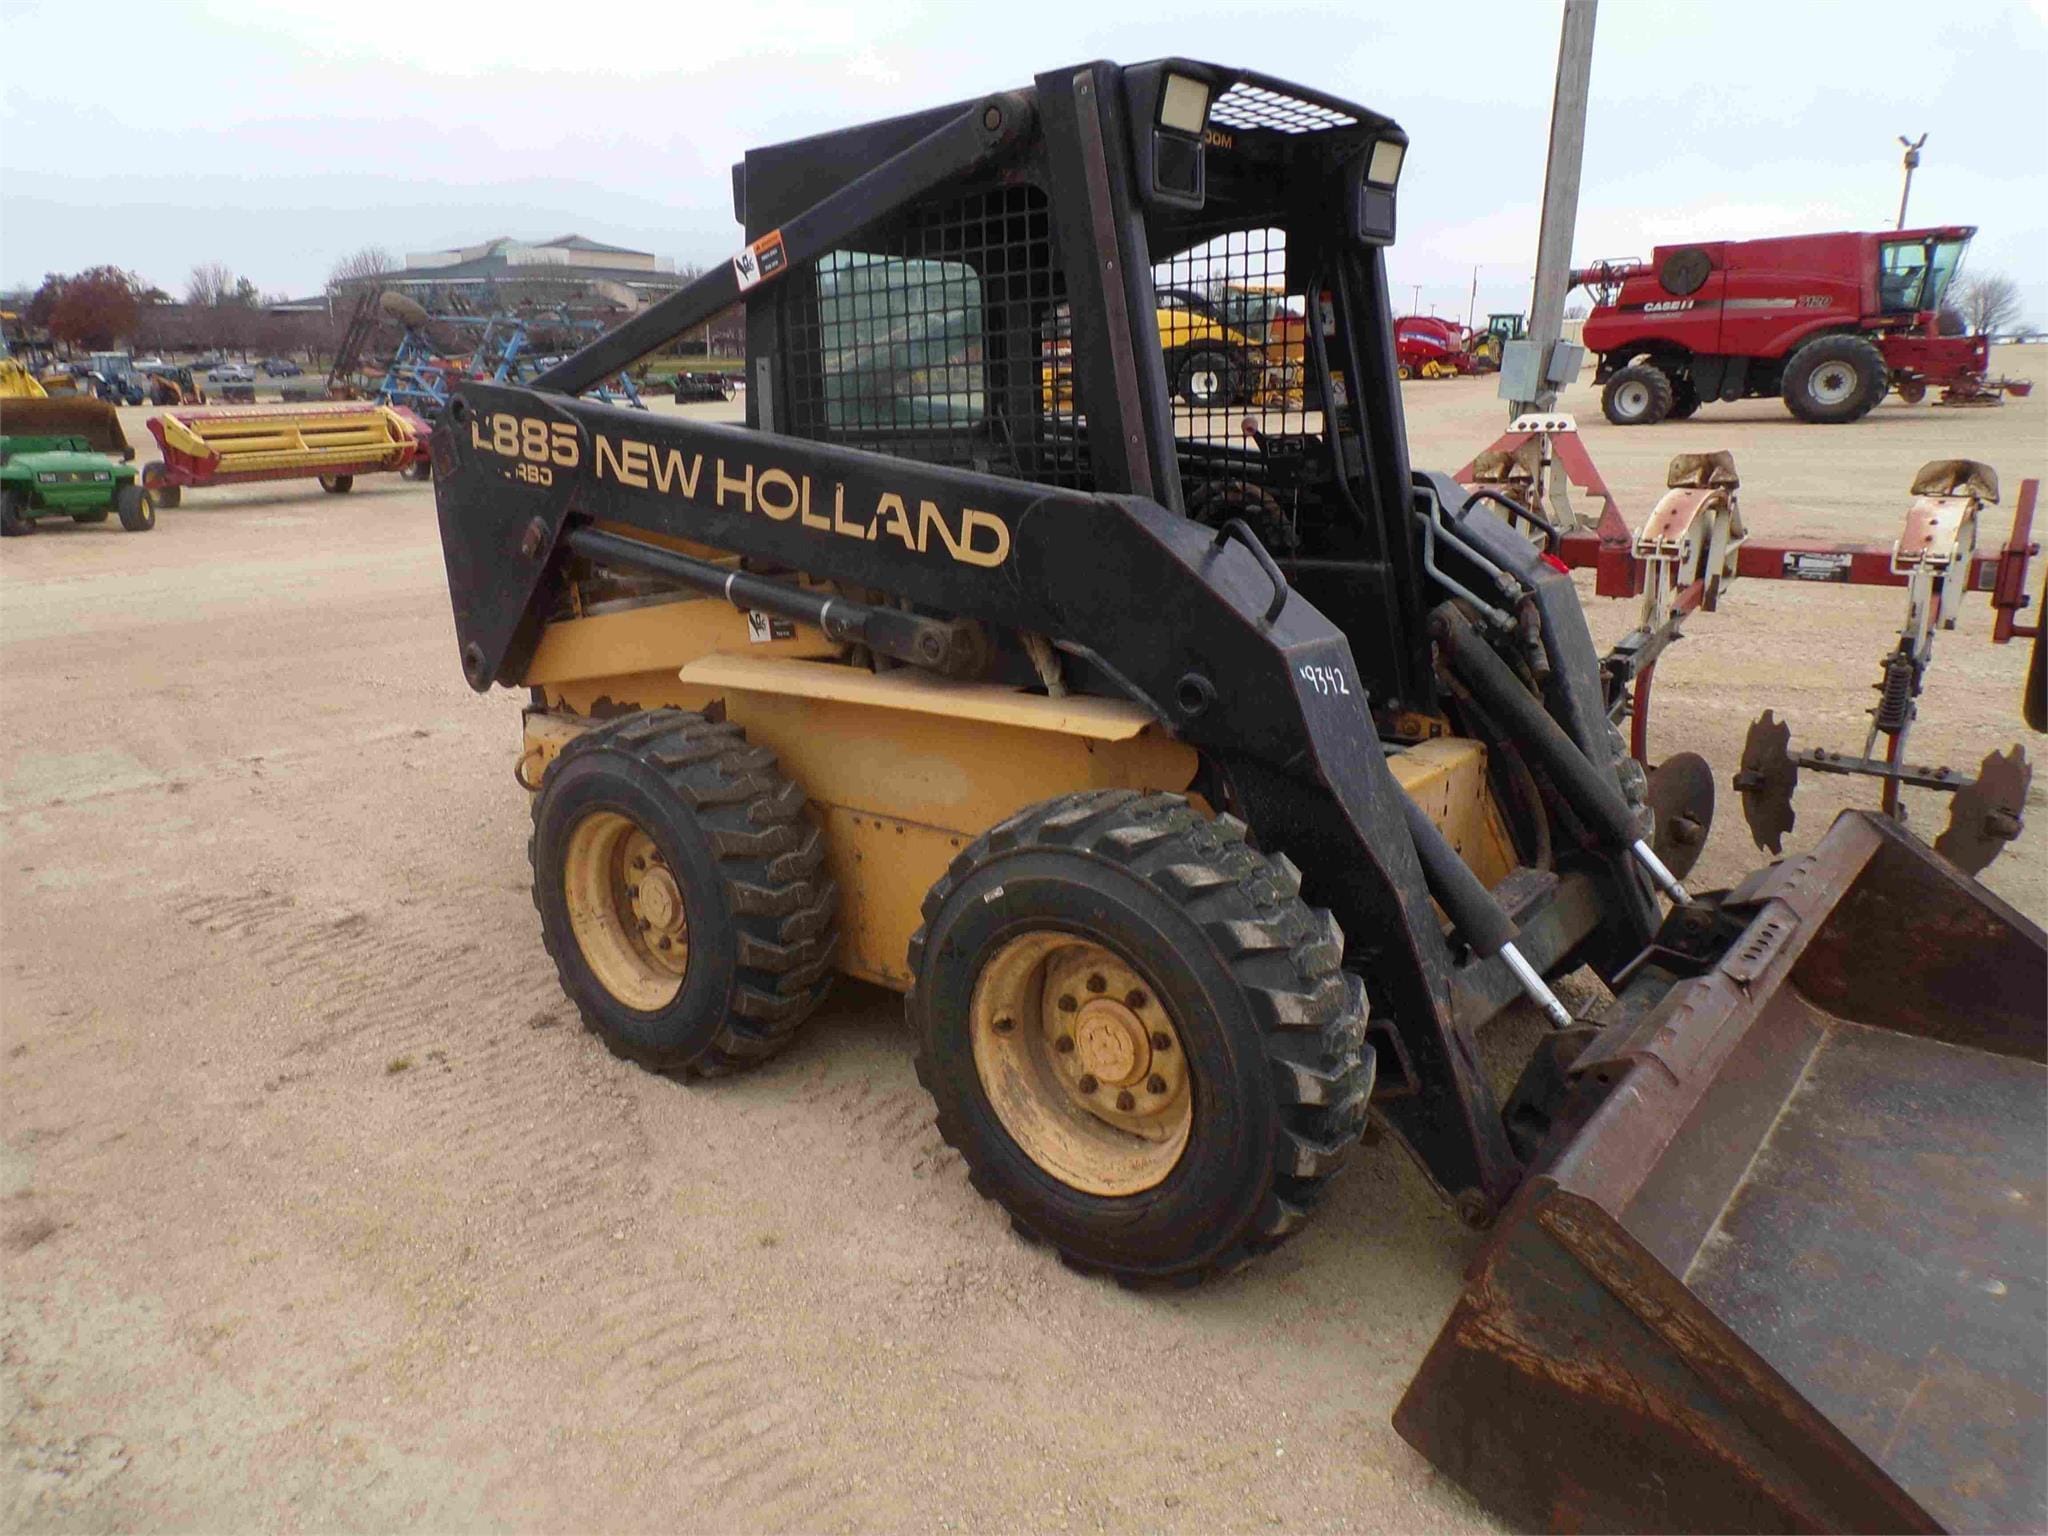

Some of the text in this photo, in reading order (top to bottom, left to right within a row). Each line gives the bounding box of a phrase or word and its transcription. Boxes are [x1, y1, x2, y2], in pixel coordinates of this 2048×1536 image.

[1643, 301, 1681, 312] CASE
[471, 409, 579, 467] L885
[595, 433, 1010, 568] NEW HOLLAND
